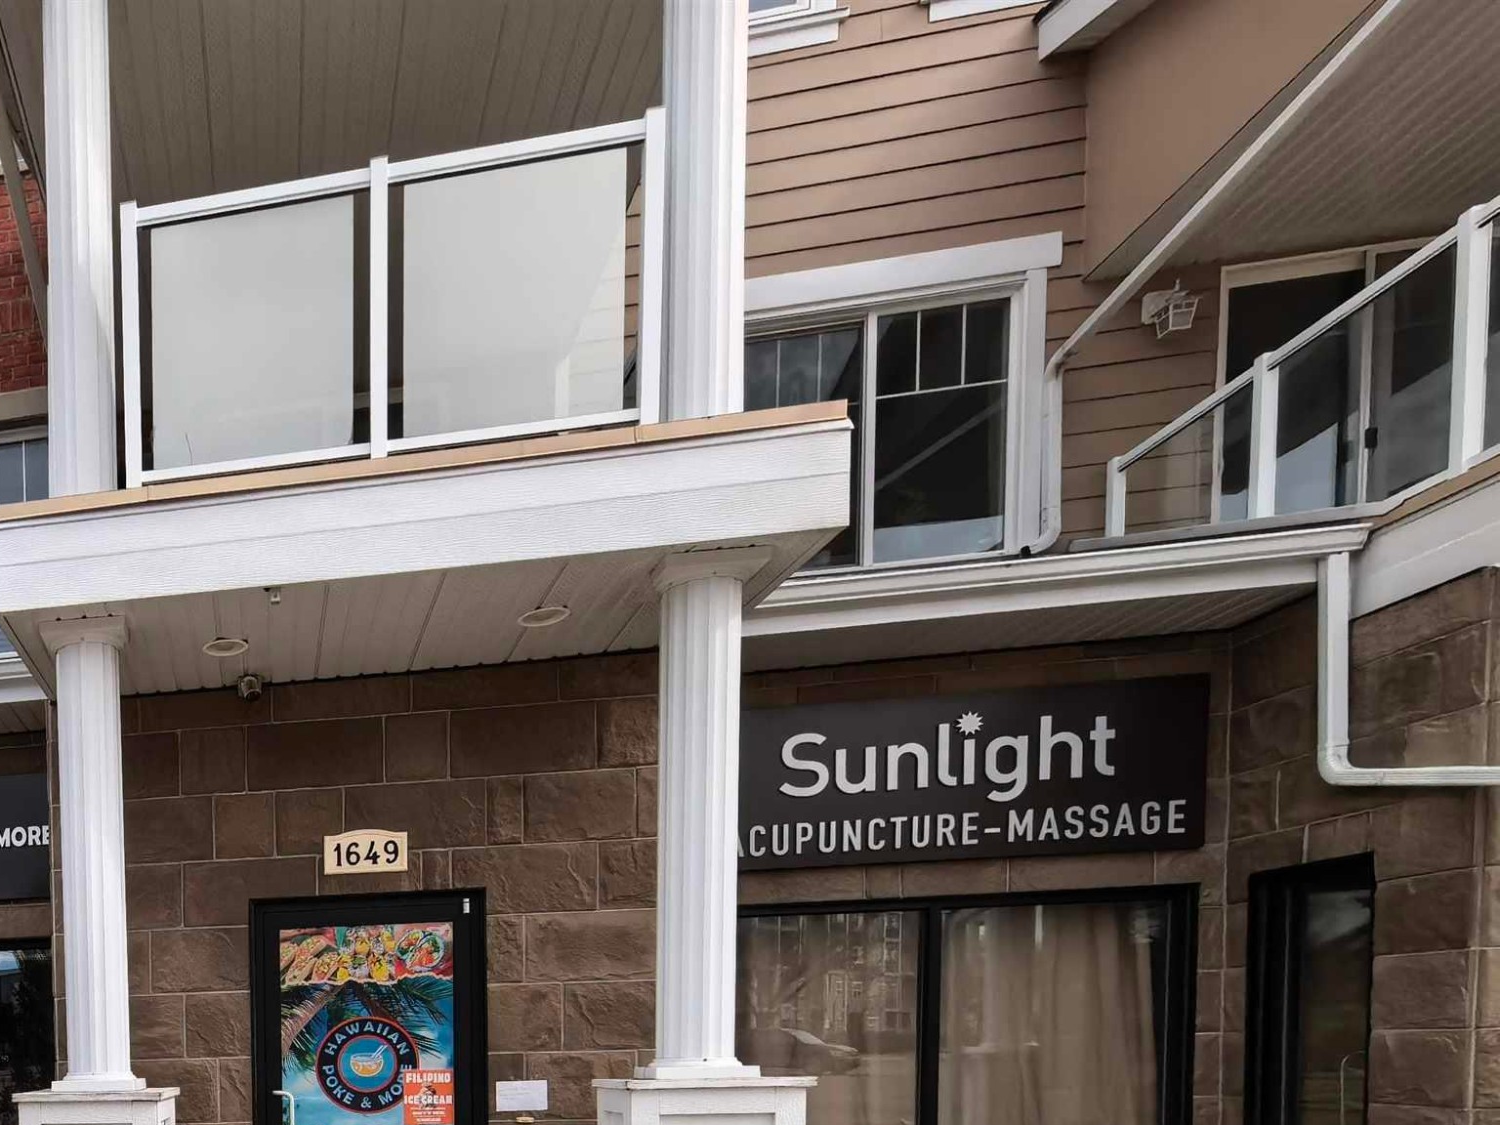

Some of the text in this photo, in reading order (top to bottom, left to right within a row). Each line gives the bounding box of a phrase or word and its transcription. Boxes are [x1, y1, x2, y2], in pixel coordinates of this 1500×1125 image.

[780, 711, 1116, 802] Sunlight
[333, 840, 399, 867] 1649
[324, 1021, 411, 1056] HAWAIIAN
[322, 1064, 356, 1105] POKE
[360, 1096, 372, 1109] &
[405, 1072, 451, 1084] FILIPINO
[403, 1094, 453, 1105] ICE CREAM
